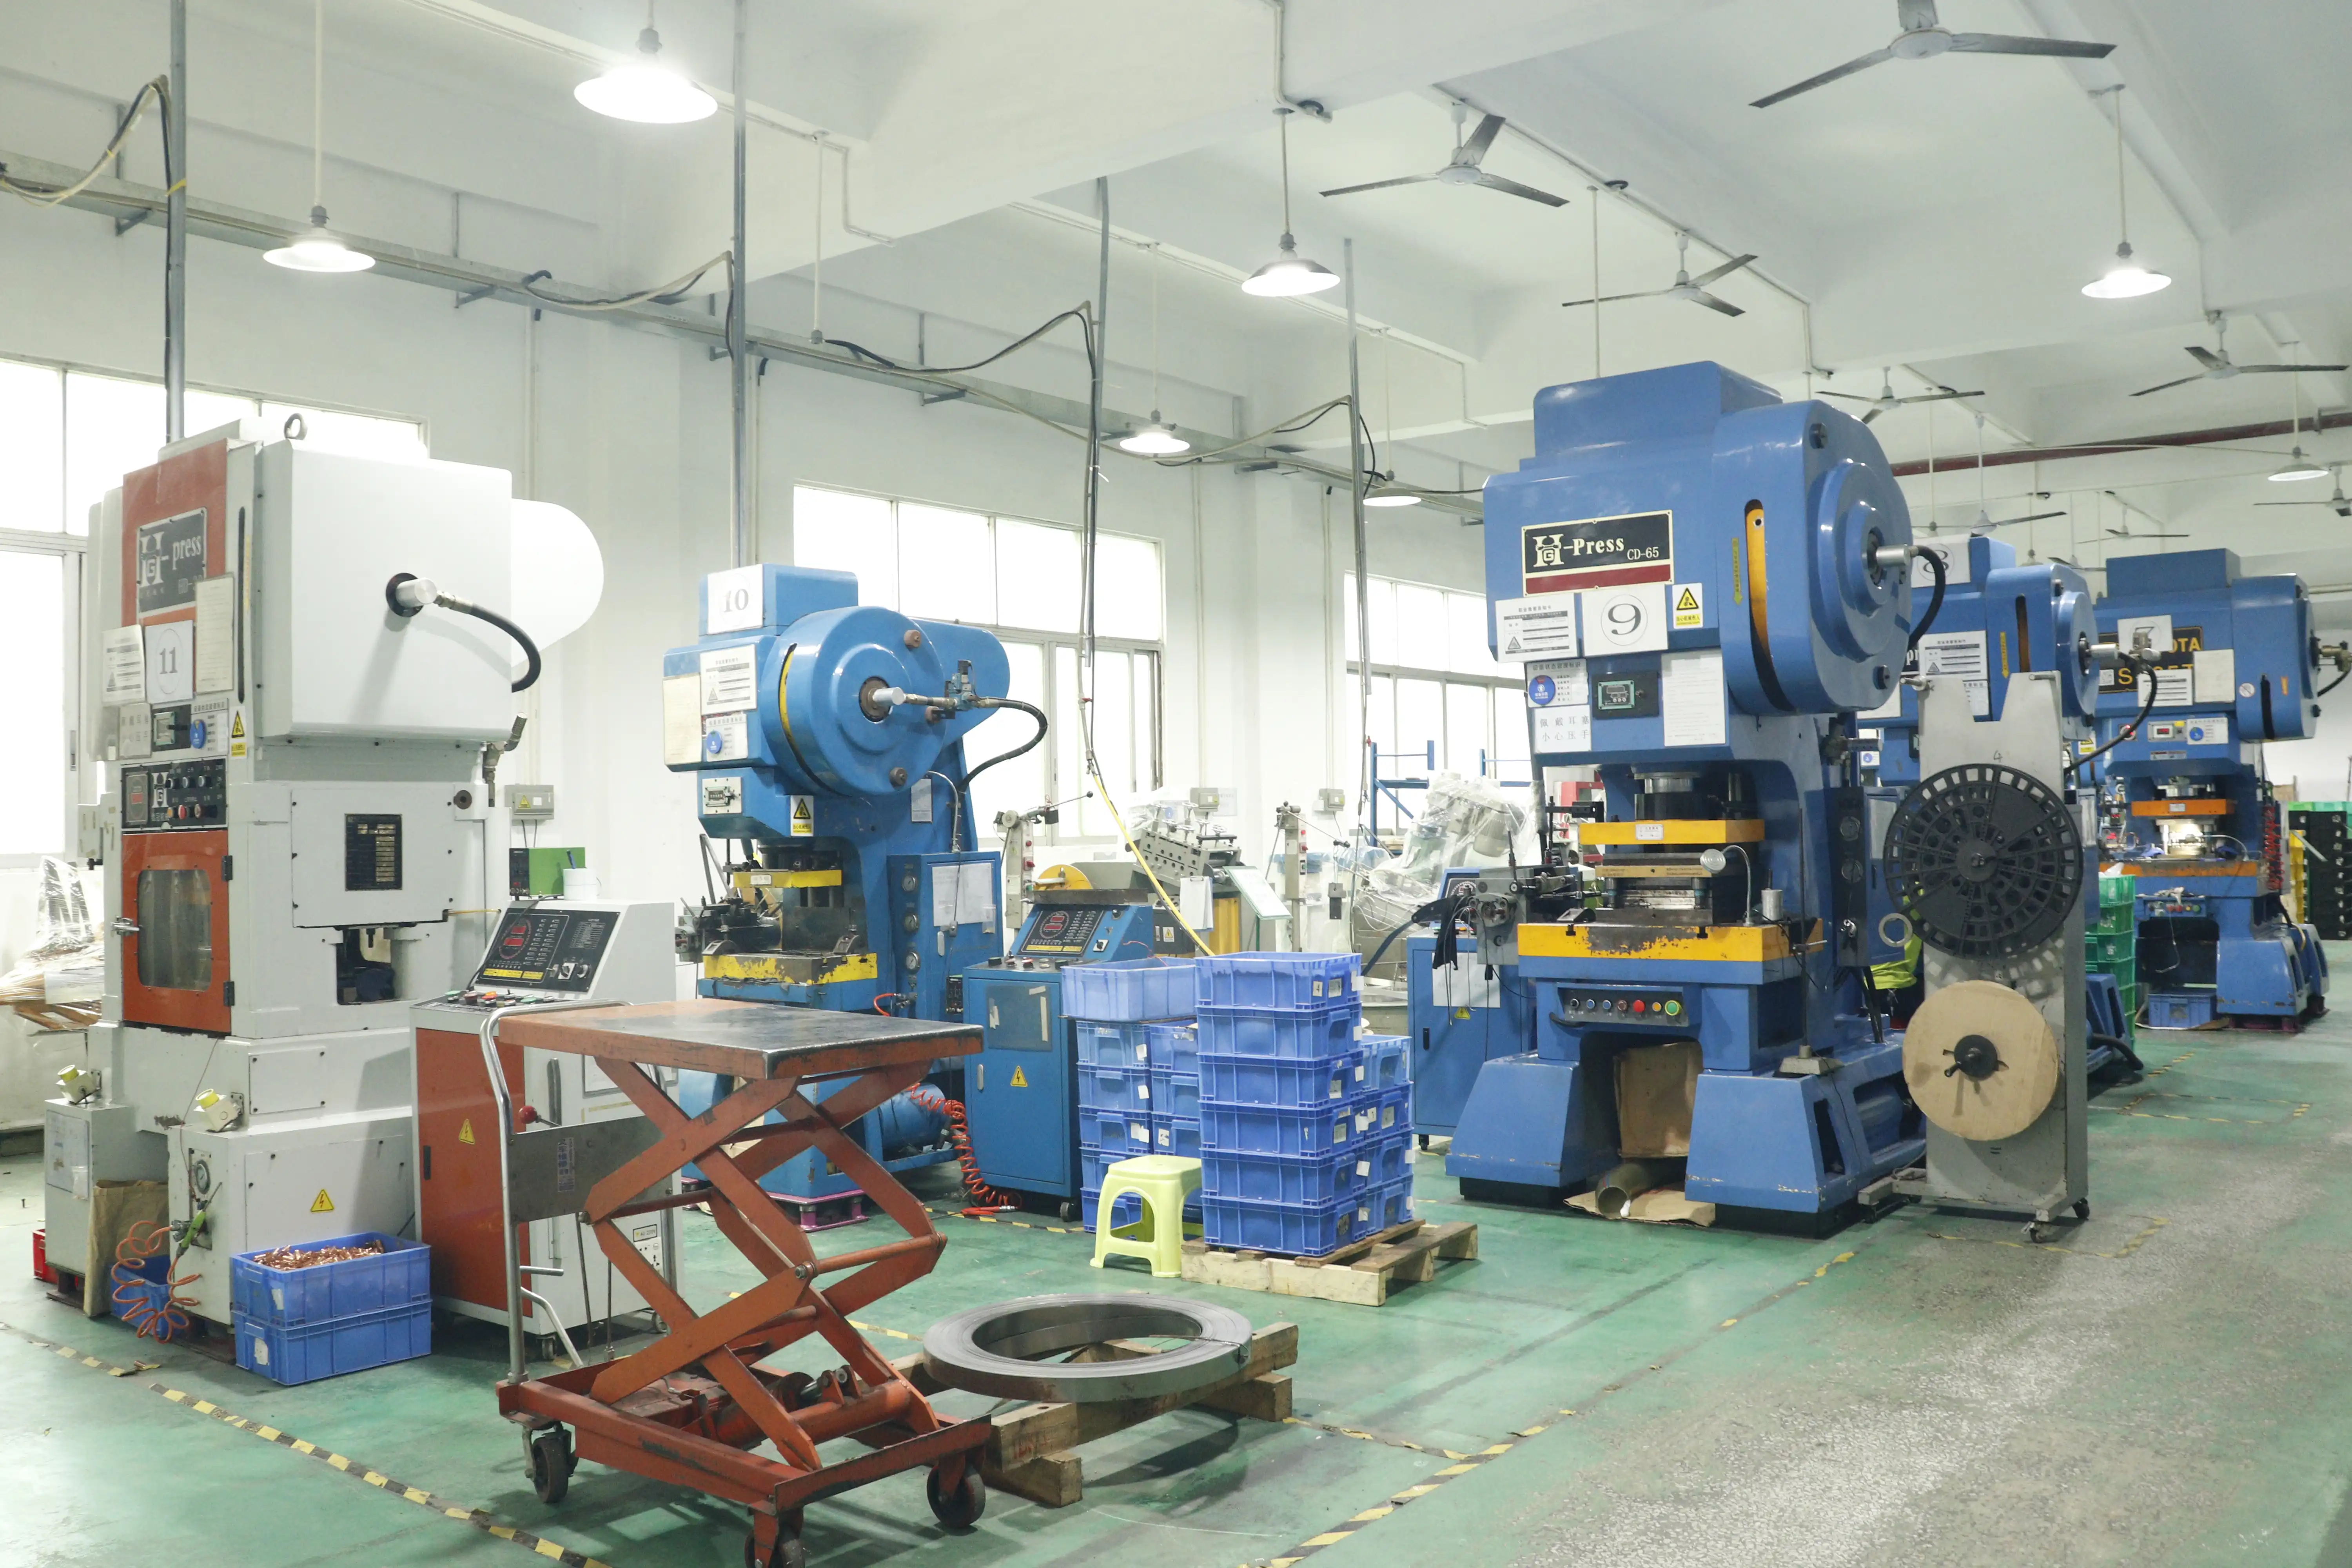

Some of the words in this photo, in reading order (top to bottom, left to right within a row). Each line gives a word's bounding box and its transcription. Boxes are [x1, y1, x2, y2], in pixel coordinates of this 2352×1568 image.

[1627, 546, 1659, 561] CD-65
[723, 588, 749, 613] 10
[1608, 604, 1642, 635] 9
[159, 647, 178, 674] 11
[1540, 715, 1589, 728] 佩戴耳塞
[1542, 729, 1589, 742] 小心压手
